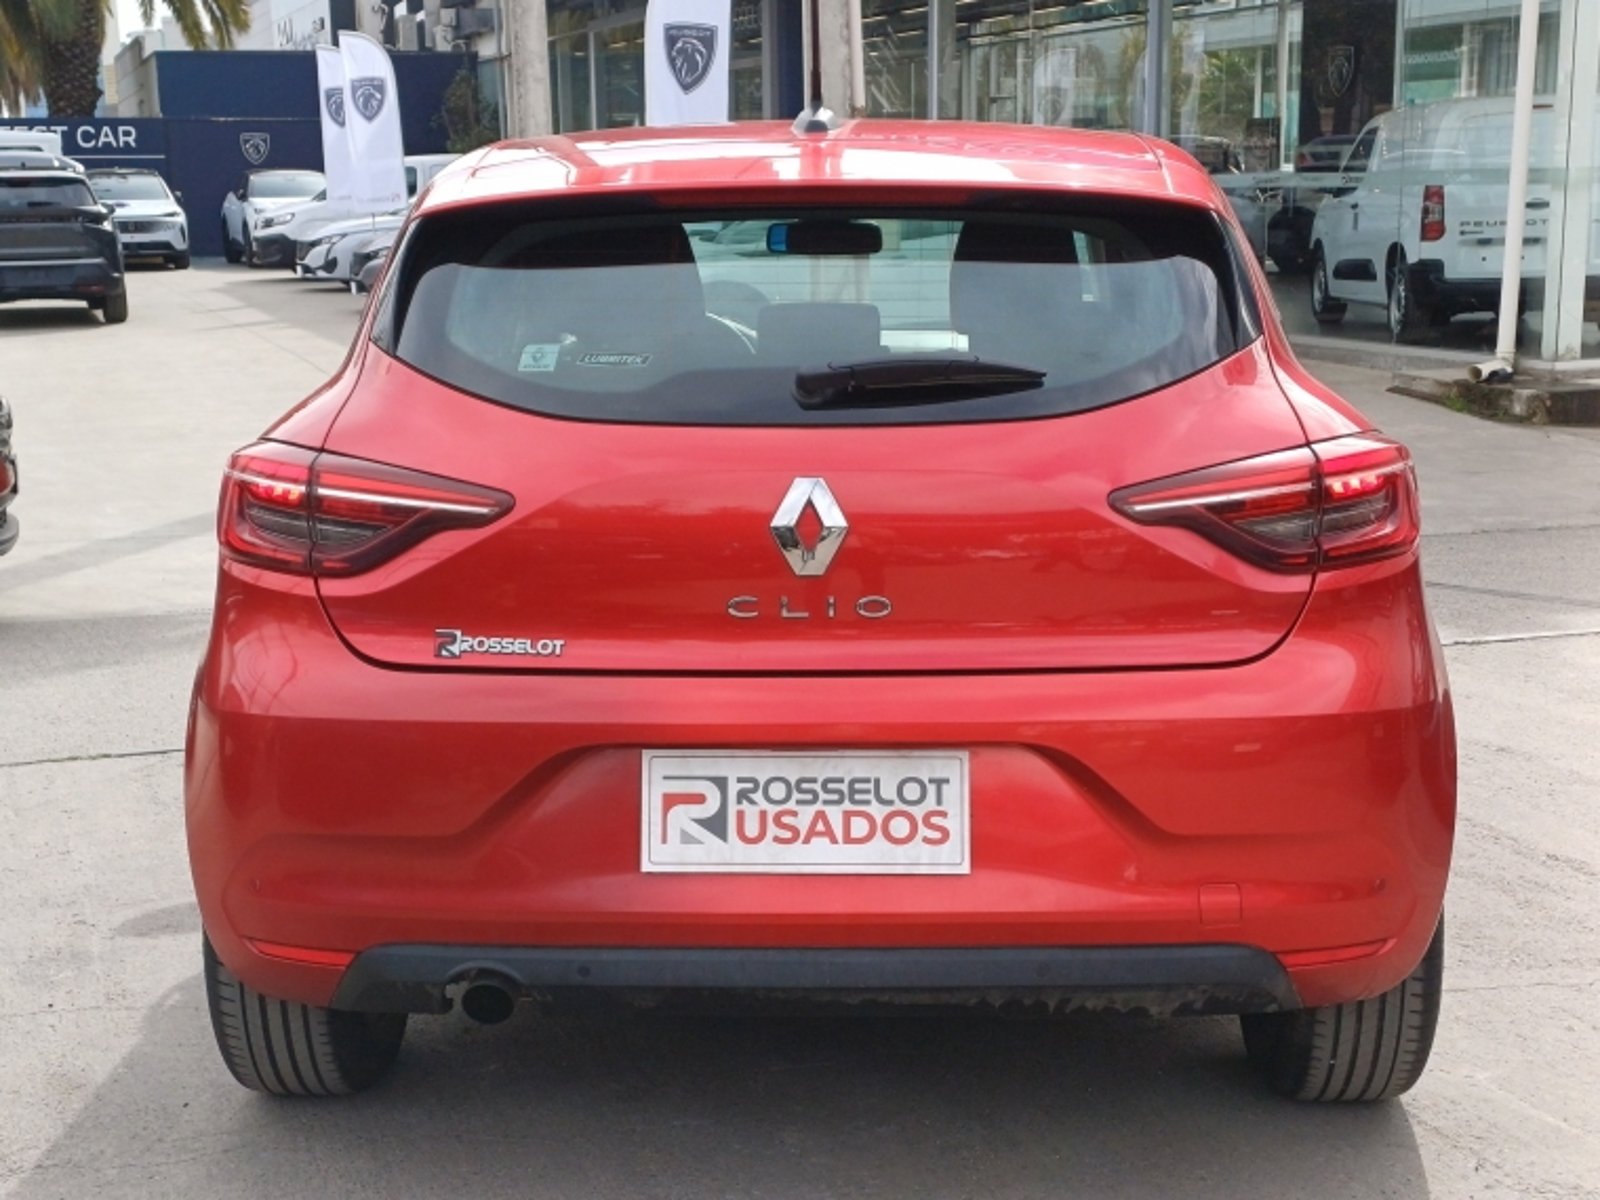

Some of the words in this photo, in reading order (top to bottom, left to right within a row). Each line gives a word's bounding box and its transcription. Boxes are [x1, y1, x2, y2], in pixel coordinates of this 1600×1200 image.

[76, 125, 137, 148] CAR
[728, 595, 892, 618] CLIO
[460, 636, 566, 656] ROSSELOT
[736, 776, 950, 807] ROSSELOT
[736, 808, 951, 847] USADOS
